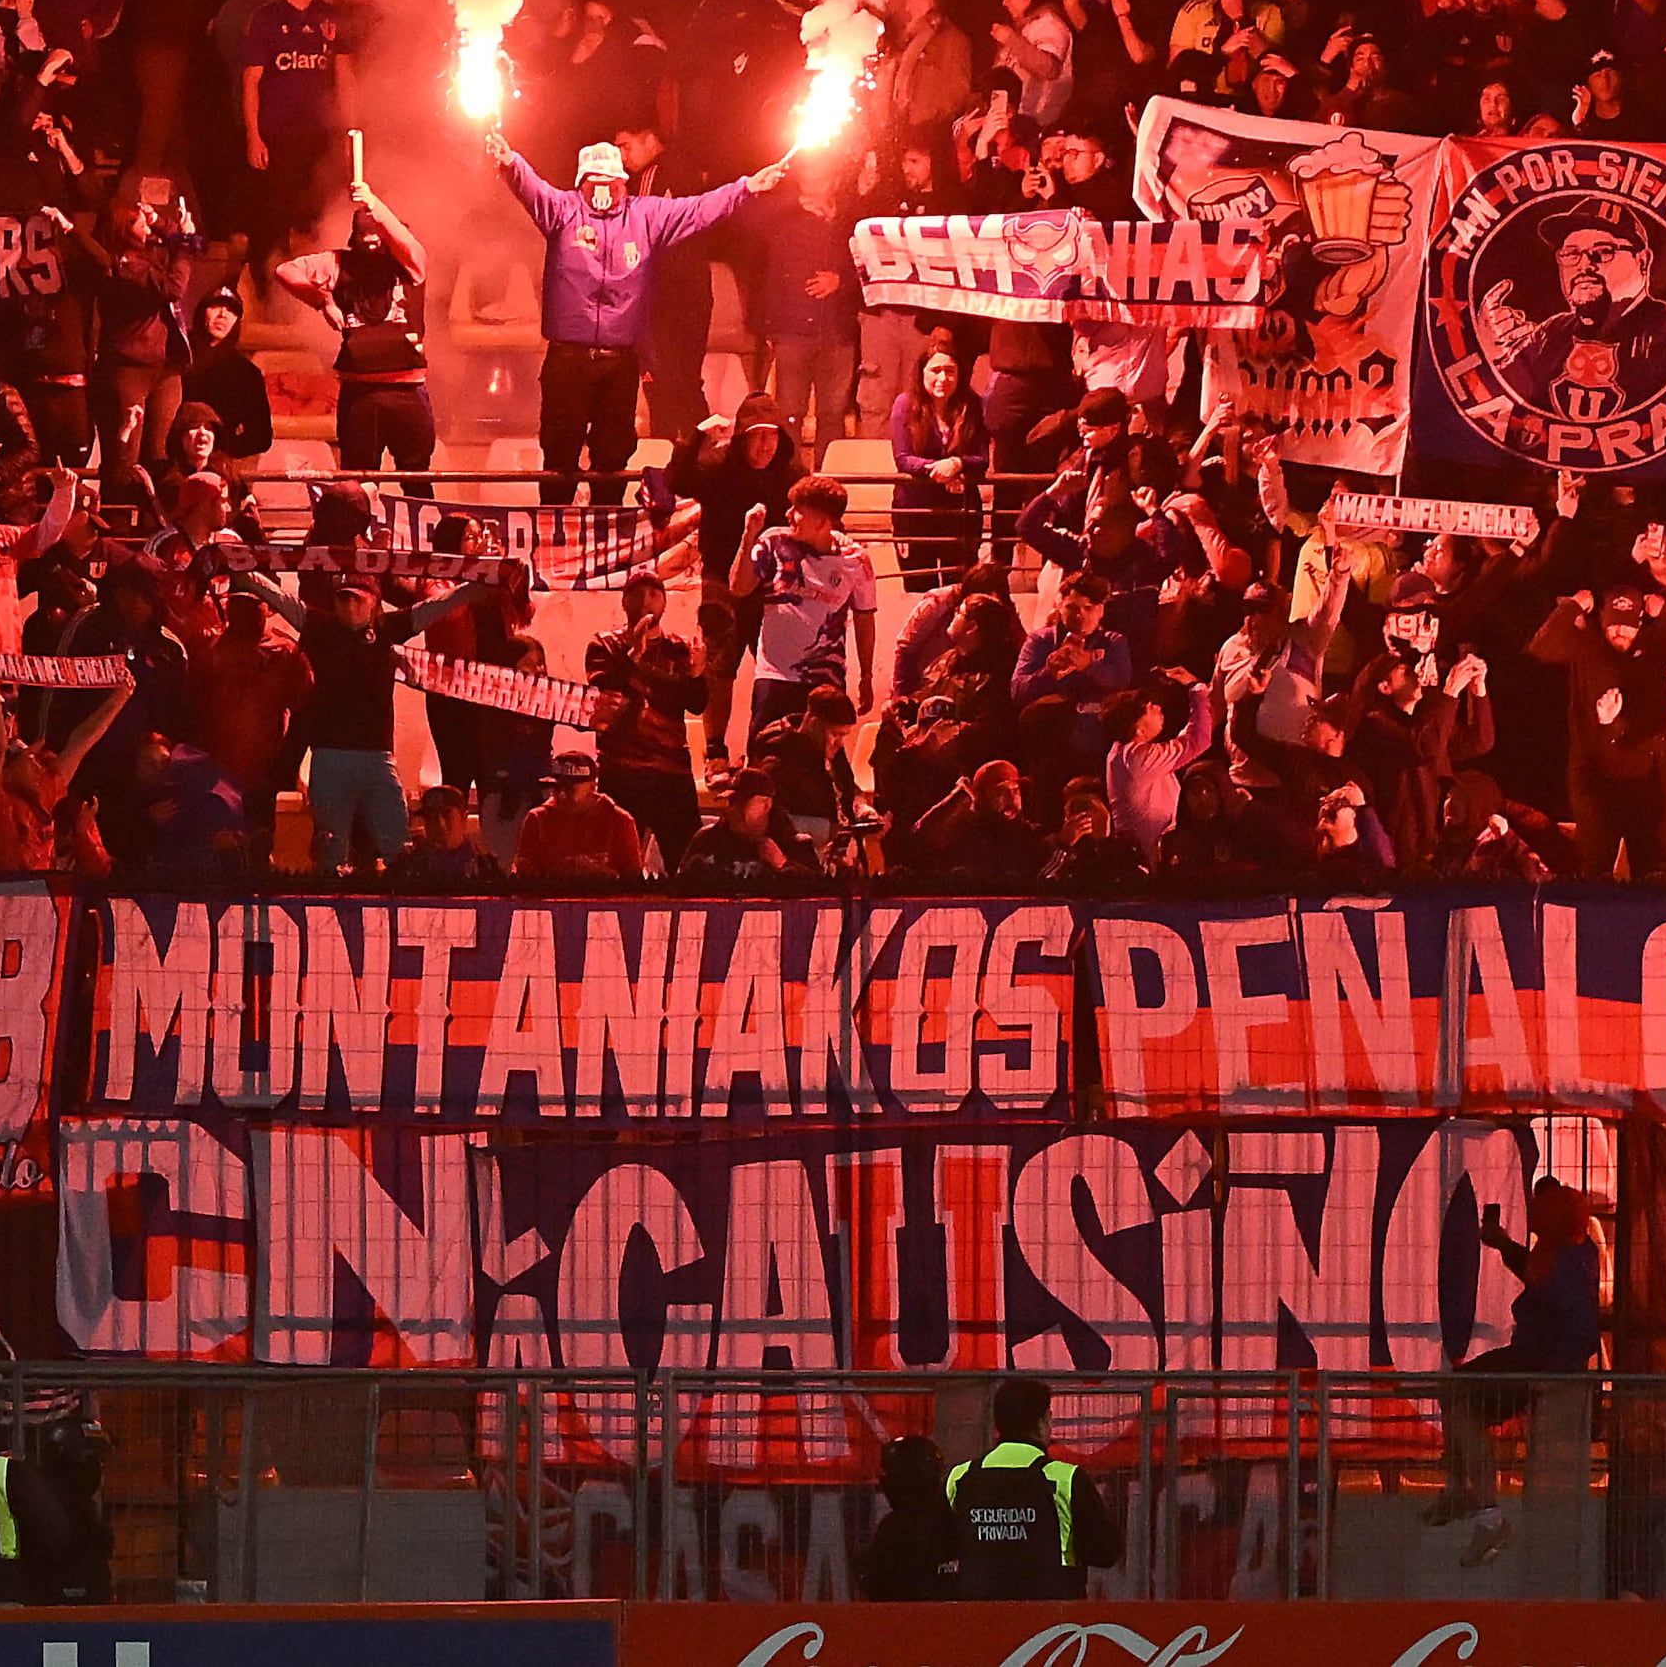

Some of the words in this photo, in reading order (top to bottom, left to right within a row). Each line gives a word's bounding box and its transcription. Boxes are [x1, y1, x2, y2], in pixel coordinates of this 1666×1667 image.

[1444, 199, 1500, 262] TAN
[1499, 149, 1579, 211] POR
[1443, 356, 1510, 438] LA
[102, 897, 1078, 1118] MONTANIAKOS
[969, 1507, 1037, 1528] SEGURIDAD
[976, 1526, 1029, 1541] PRIVADA
